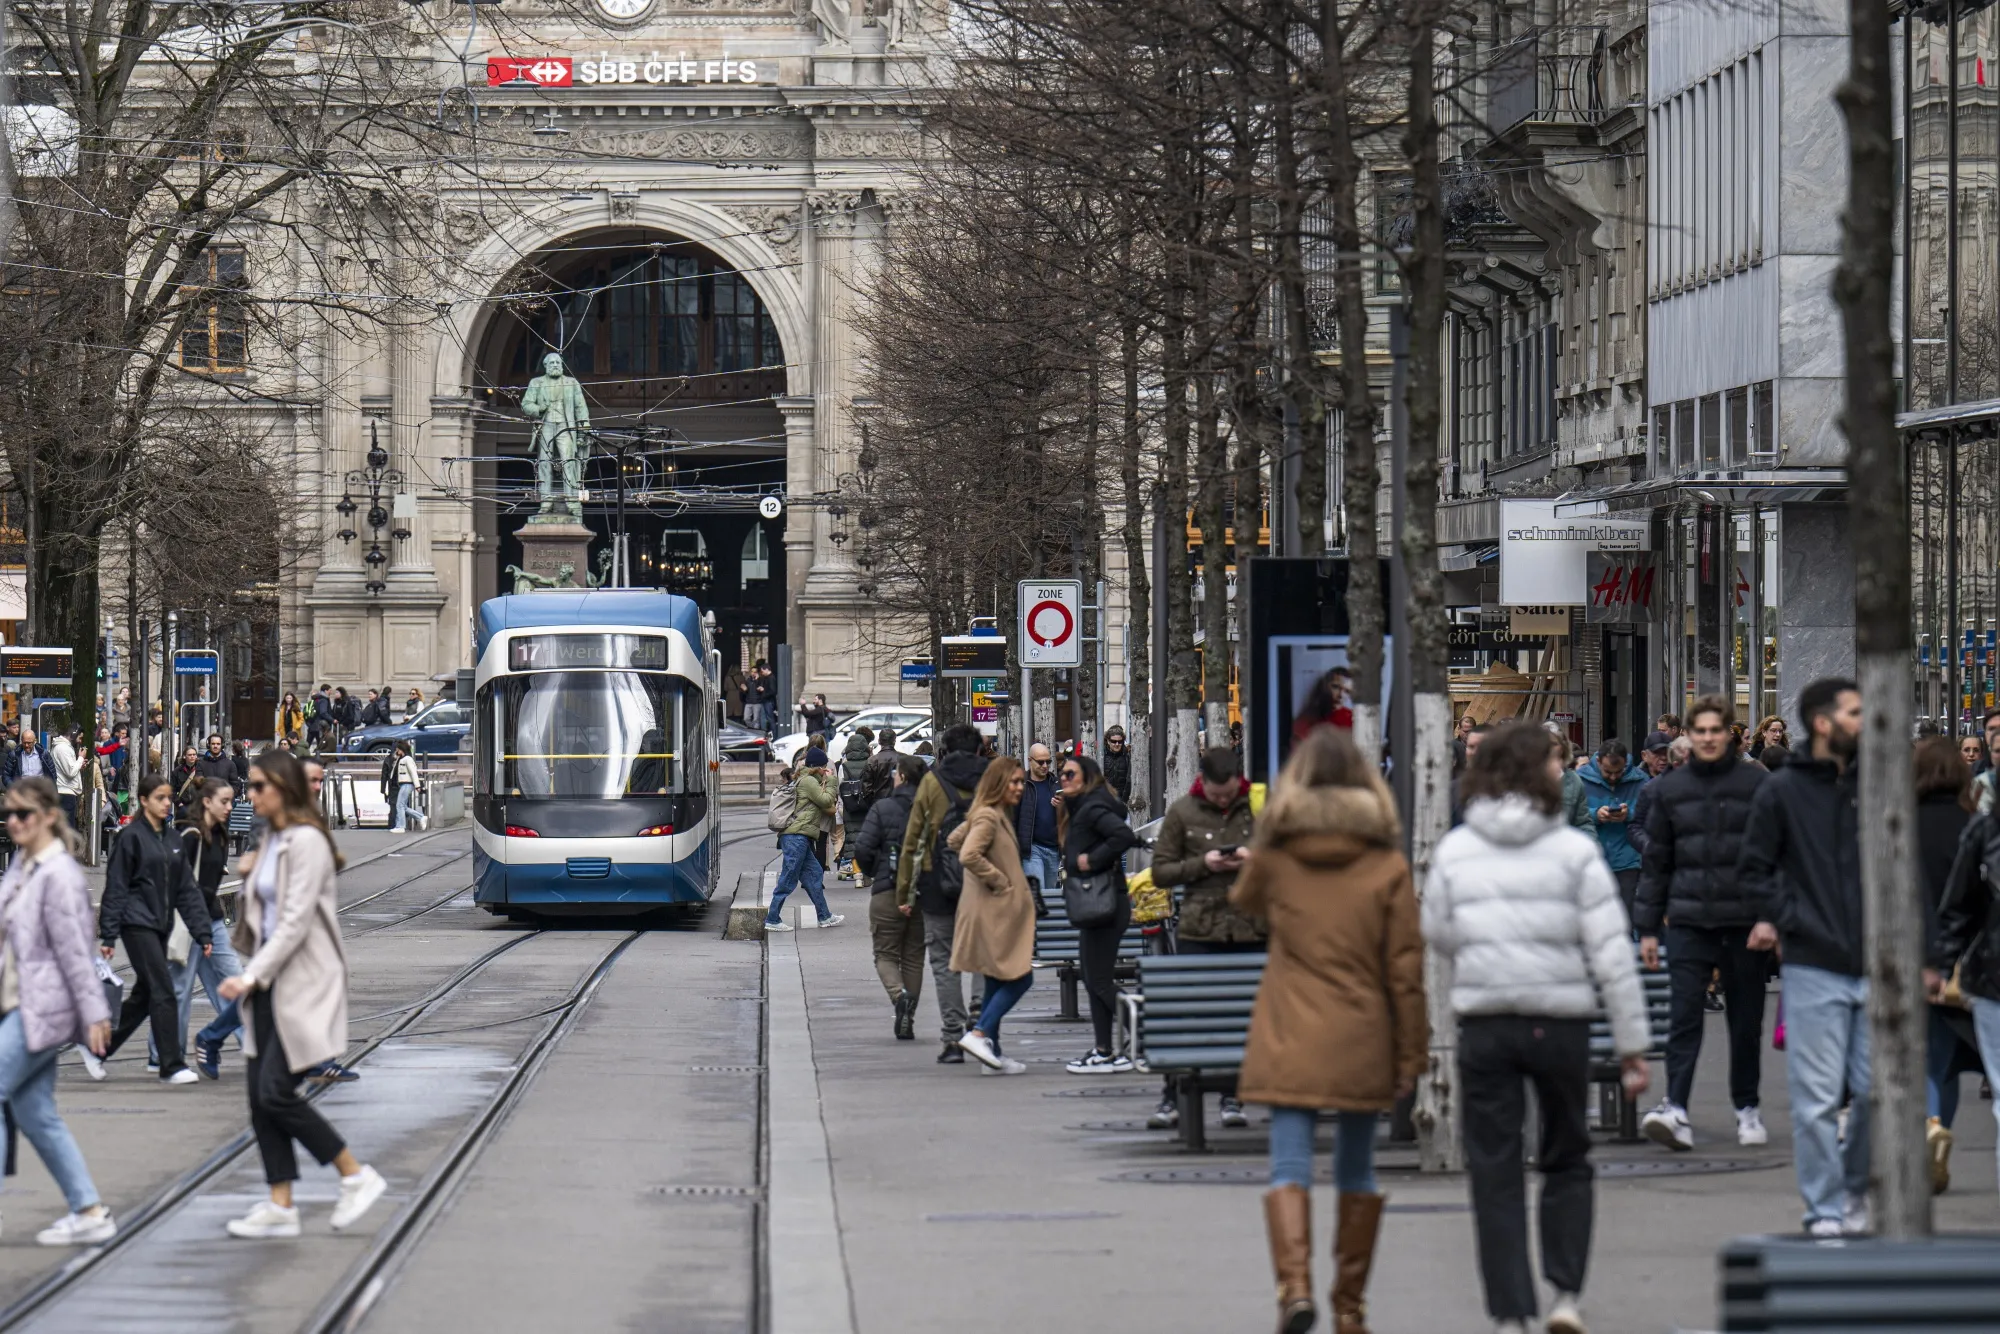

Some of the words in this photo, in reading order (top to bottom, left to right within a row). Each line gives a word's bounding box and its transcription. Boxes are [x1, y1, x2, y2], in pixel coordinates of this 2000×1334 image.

[580, 61, 637, 83] SBB
[643, 61, 696, 83] CFF
[705, 61, 757, 83] FFS
[764, 502, 777, 513] 12
[1508, 526, 1645, 541] schminkbar
[534, 549, 573, 557] ALFRED
[1593, 566, 1656, 608] H&M
[1037, 589, 1063, 599] ZONE
[518, 643, 542, 661] 17
[977, 683, 986, 691] 11
[976, 697, 986, 706] 13
[976, 712, 986, 721] 17
